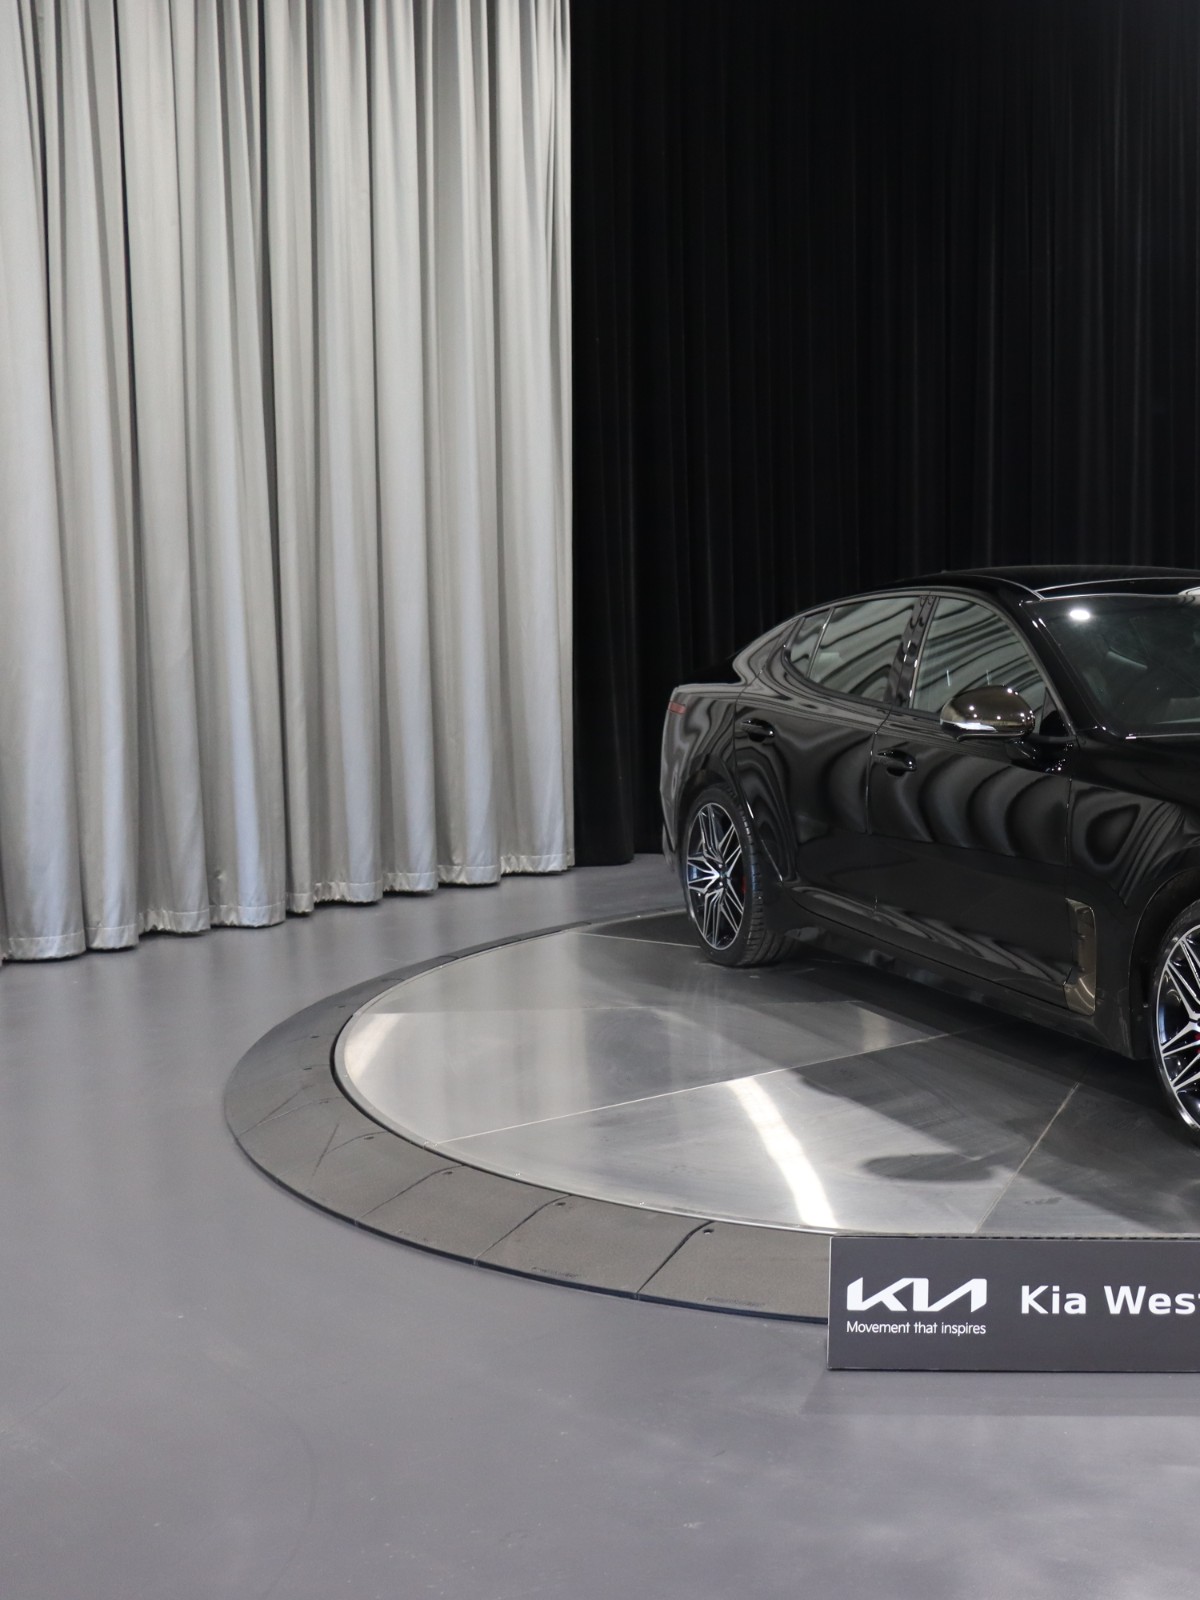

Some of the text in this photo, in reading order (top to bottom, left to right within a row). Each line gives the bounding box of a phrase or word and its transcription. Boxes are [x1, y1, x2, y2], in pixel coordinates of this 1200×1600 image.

[846, 1276, 988, 1313] KIA
[1020, 1284, 1088, 1316] Kia
[846, 1320, 987, 1337] Movement that inspires
